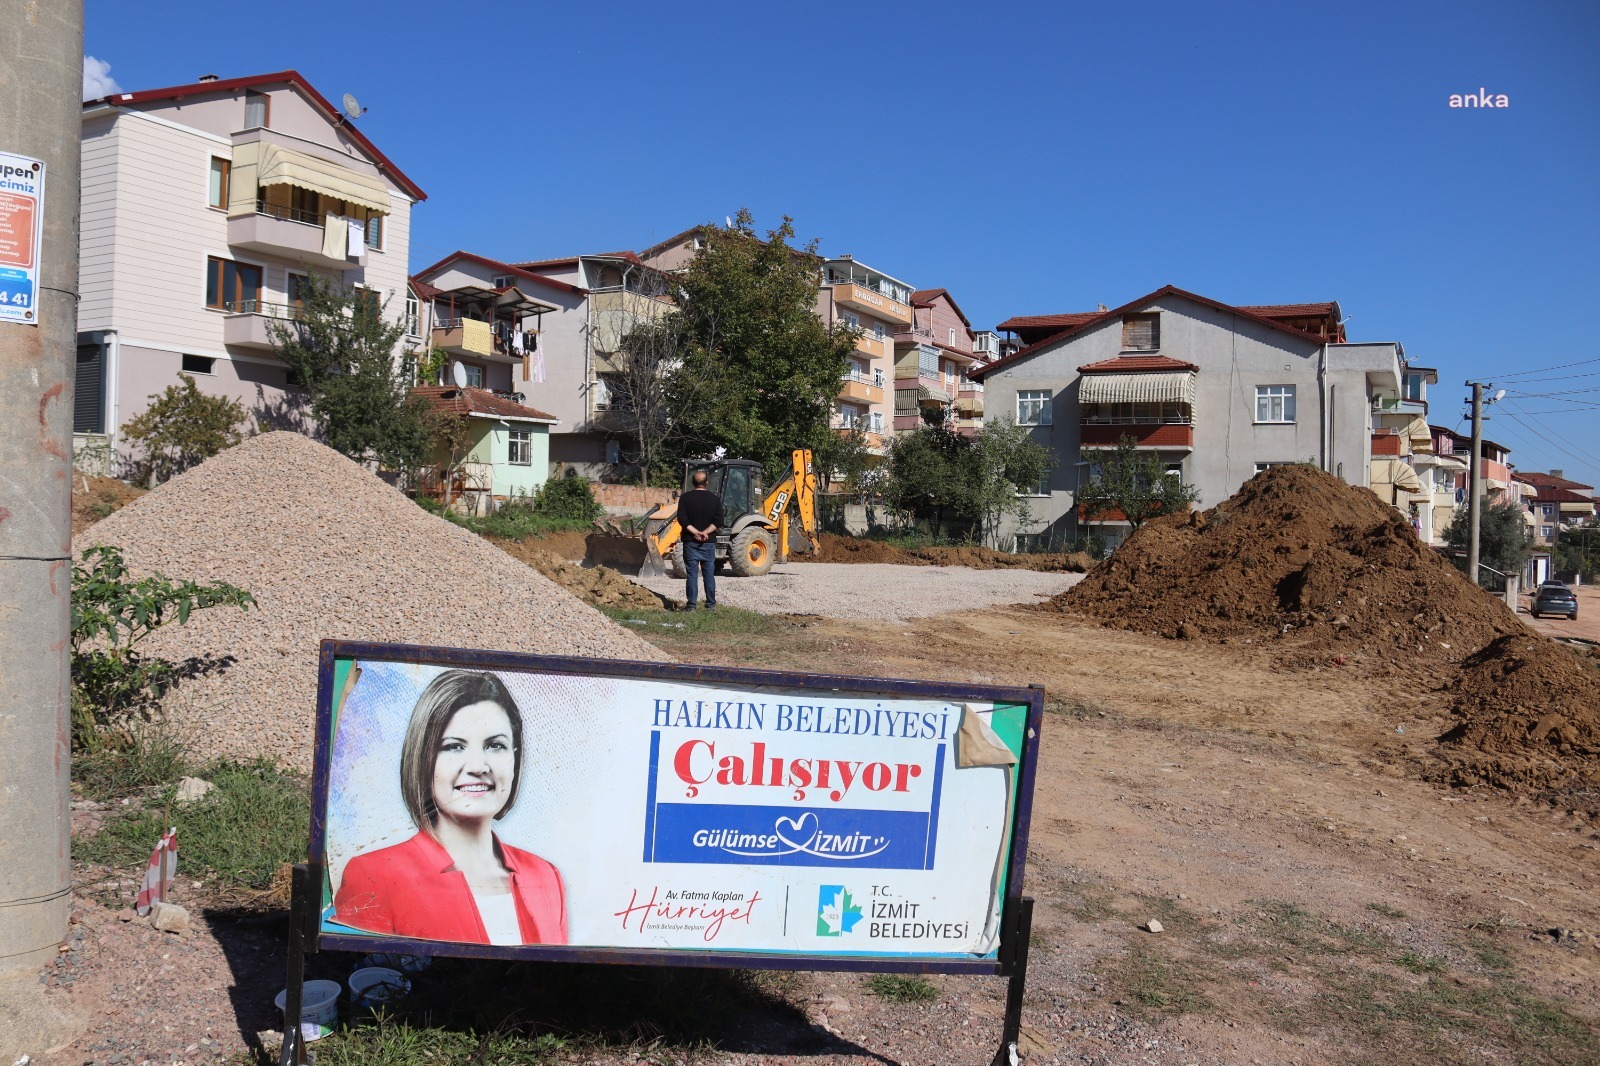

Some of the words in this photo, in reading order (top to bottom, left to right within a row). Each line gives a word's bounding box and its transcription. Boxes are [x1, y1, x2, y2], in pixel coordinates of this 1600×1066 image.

[0, 165, 34, 179] pen
[11, 292, 28, 306] 41
[769, 491, 788, 522] JCB
[650, 698, 767, 731] HALKIN
[774, 703, 949, 740] BELEDİYESİ
[673, 739, 922, 803] Çalışıyor
[692, 829, 778, 849] Gülümse
[814, 831, 872, 853] İZMİT
[665, 890, 678, 900] Av.
[681, 890, 710, 901] Fatma
[711, 891, 744, 903] Kaplan
[872, 885, 893, 897] T.C.
[614, 886, 763, 942] Hürriyet
[871, 900, 920, 919] İZMİT
[870, 920, 969, 939] BELEDİYESİ
